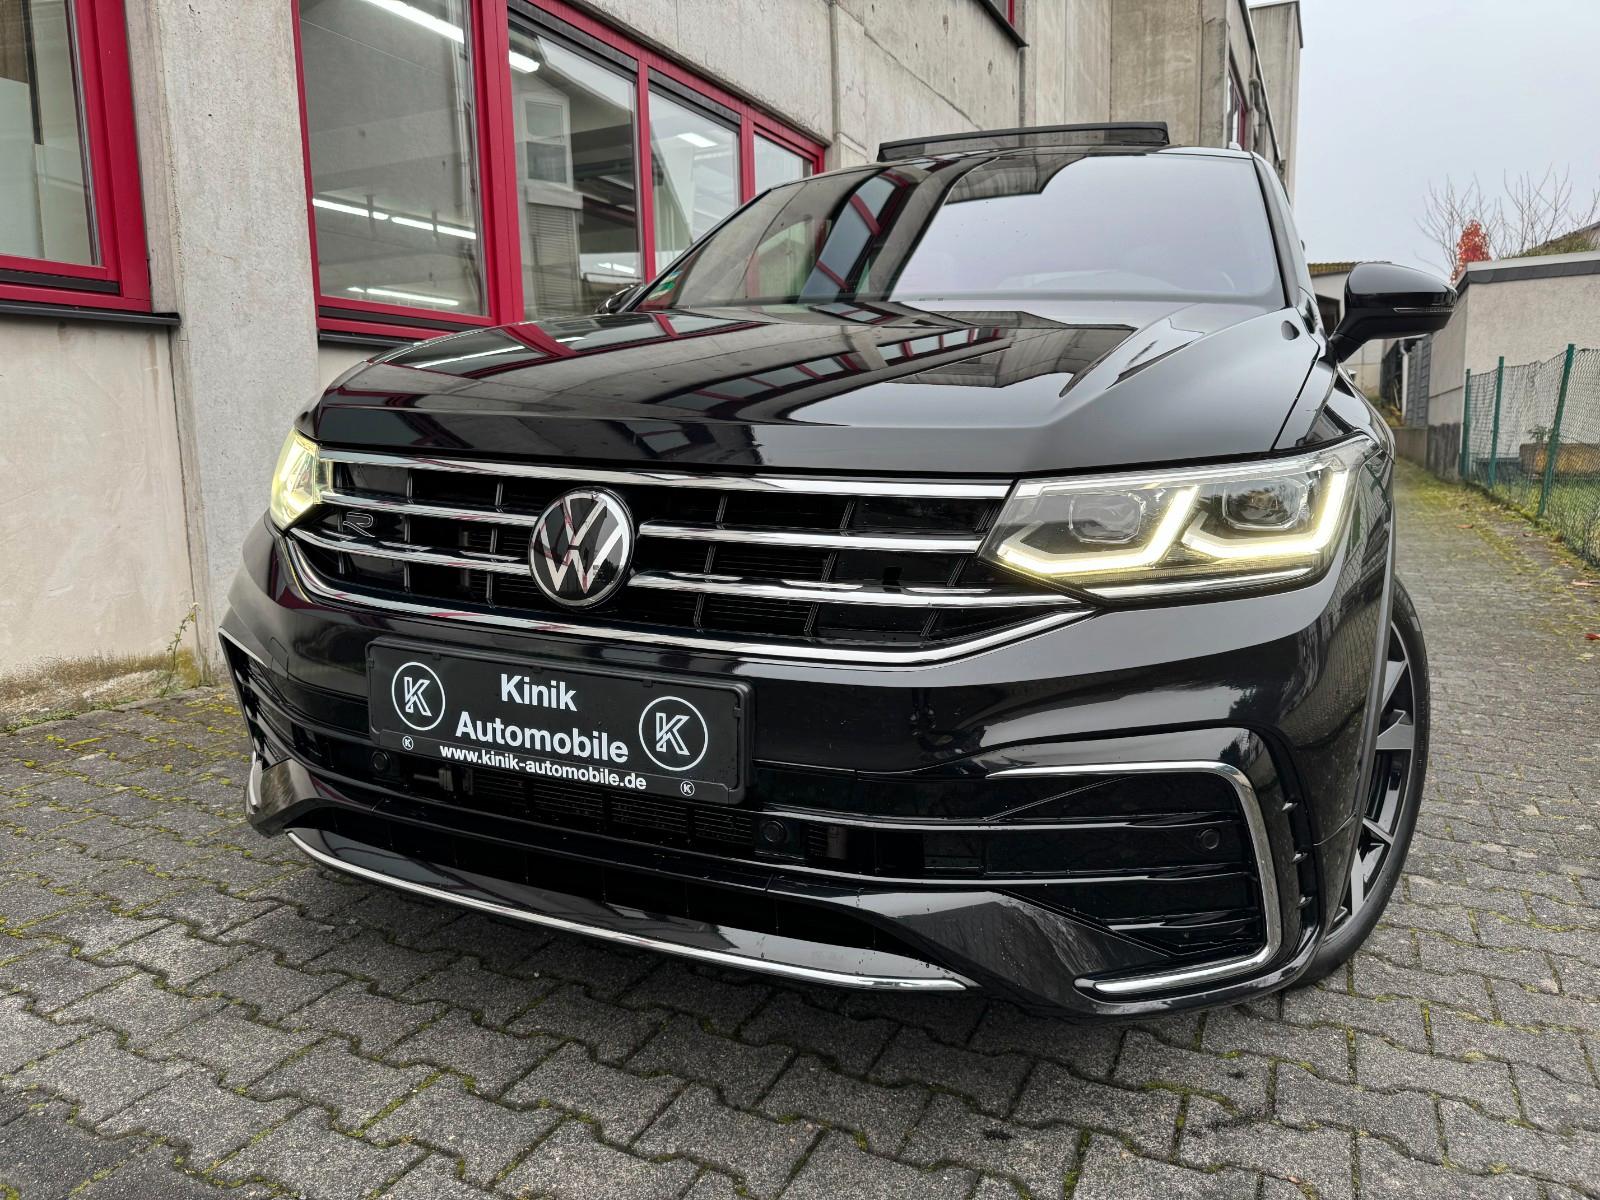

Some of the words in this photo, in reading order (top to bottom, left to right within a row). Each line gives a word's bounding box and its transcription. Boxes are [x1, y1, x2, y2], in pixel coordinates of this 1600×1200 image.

[342, 512, 376, 537] R
[500, 673, 577, 712] Kinik
[455, 711, 629, 764] Automobile
[439, 745, 647, 791] www.kinik-automobile.de
